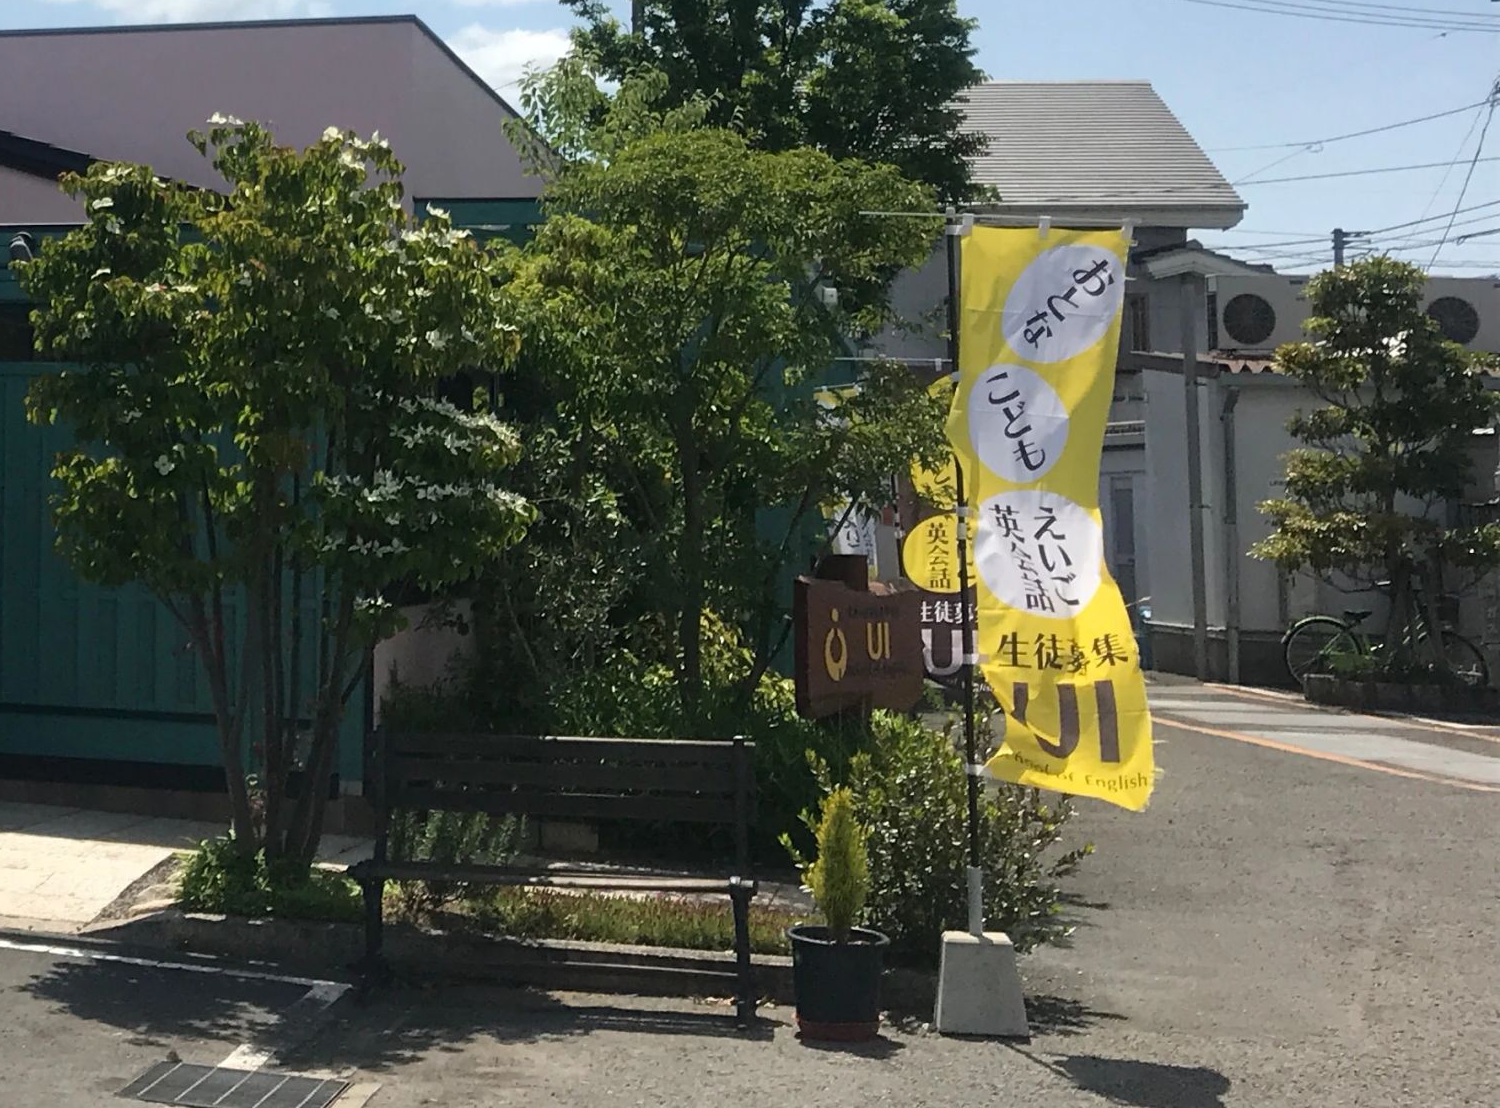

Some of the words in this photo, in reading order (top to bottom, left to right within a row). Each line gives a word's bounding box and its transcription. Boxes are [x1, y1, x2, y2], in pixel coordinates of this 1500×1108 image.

[1023, 258, 1116, 348] おとな
[987, 371, 1047, 472] こども
[927, 522, 950, 589] 英会話
[1033, 506, 1080, 607] えいご
[866, 621, 890, 660] UI
[920, 600, 979, 624] 生徒募
[996, 631, 1129, 676] 生徒募集
[1011, 680, 1121, 763] UI
[1084, 772, 1148, 793] English
